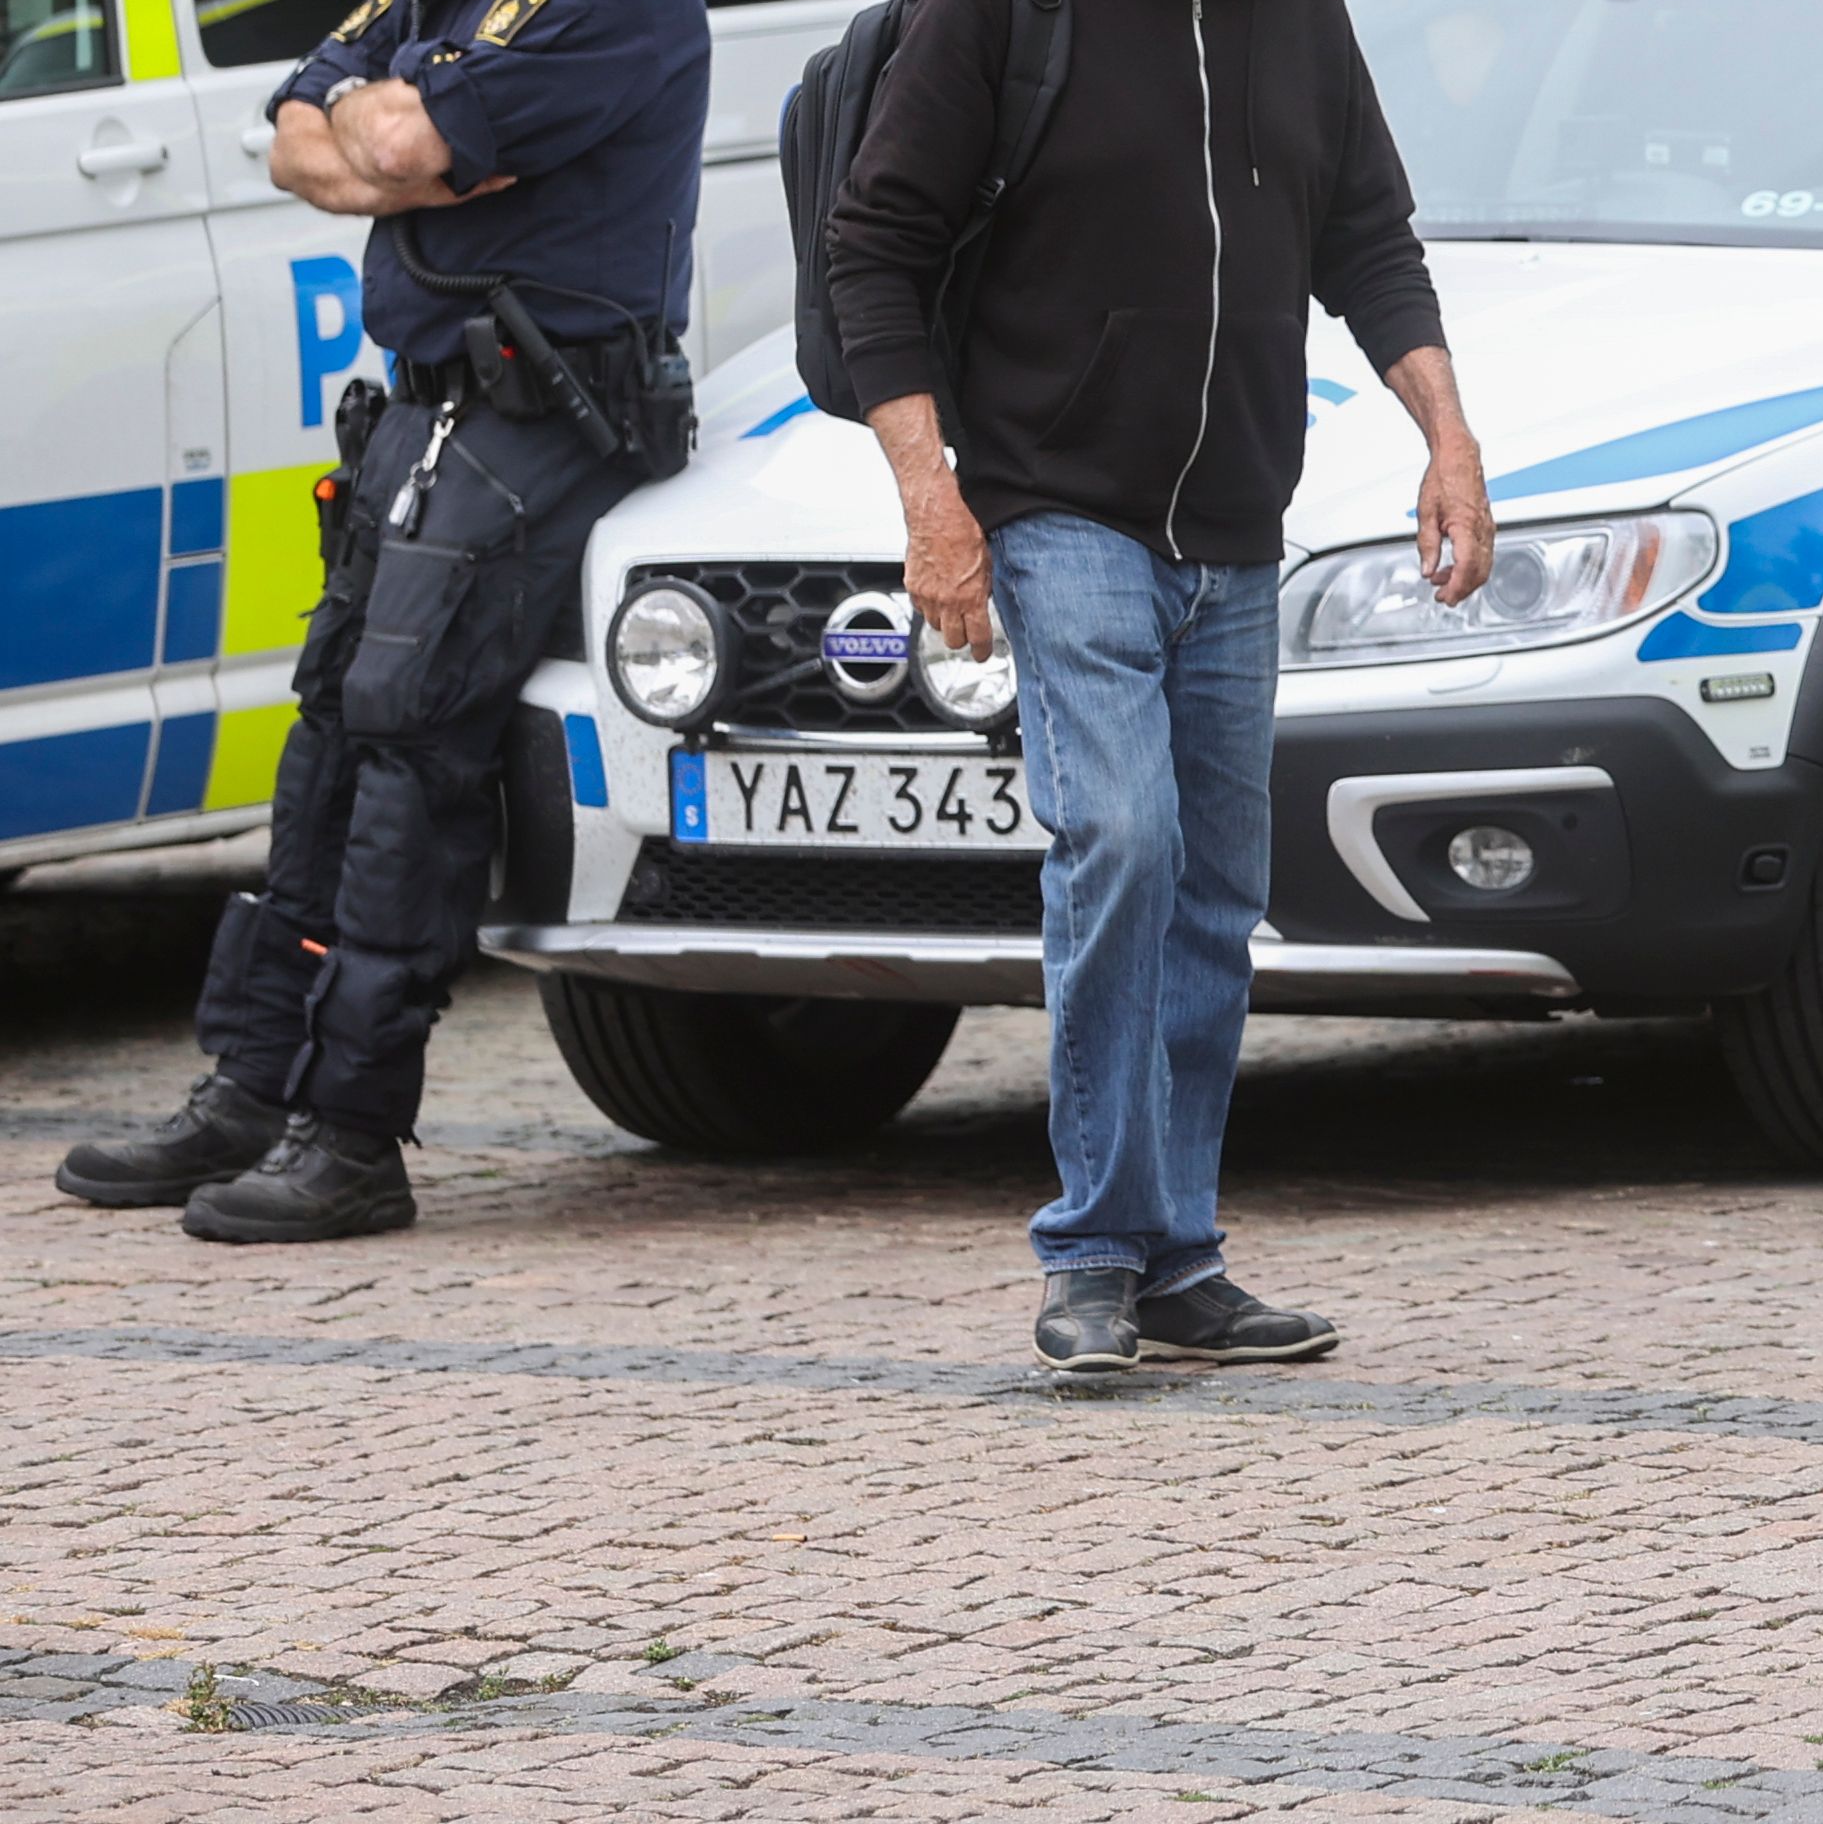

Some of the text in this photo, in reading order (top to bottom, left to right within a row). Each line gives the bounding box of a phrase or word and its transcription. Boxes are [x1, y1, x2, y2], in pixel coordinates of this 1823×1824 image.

[827, 636, 906, 655] VOLVO
[730, 761, 1021, 835] YAZ 343
[684, 806, 699, 827] S
